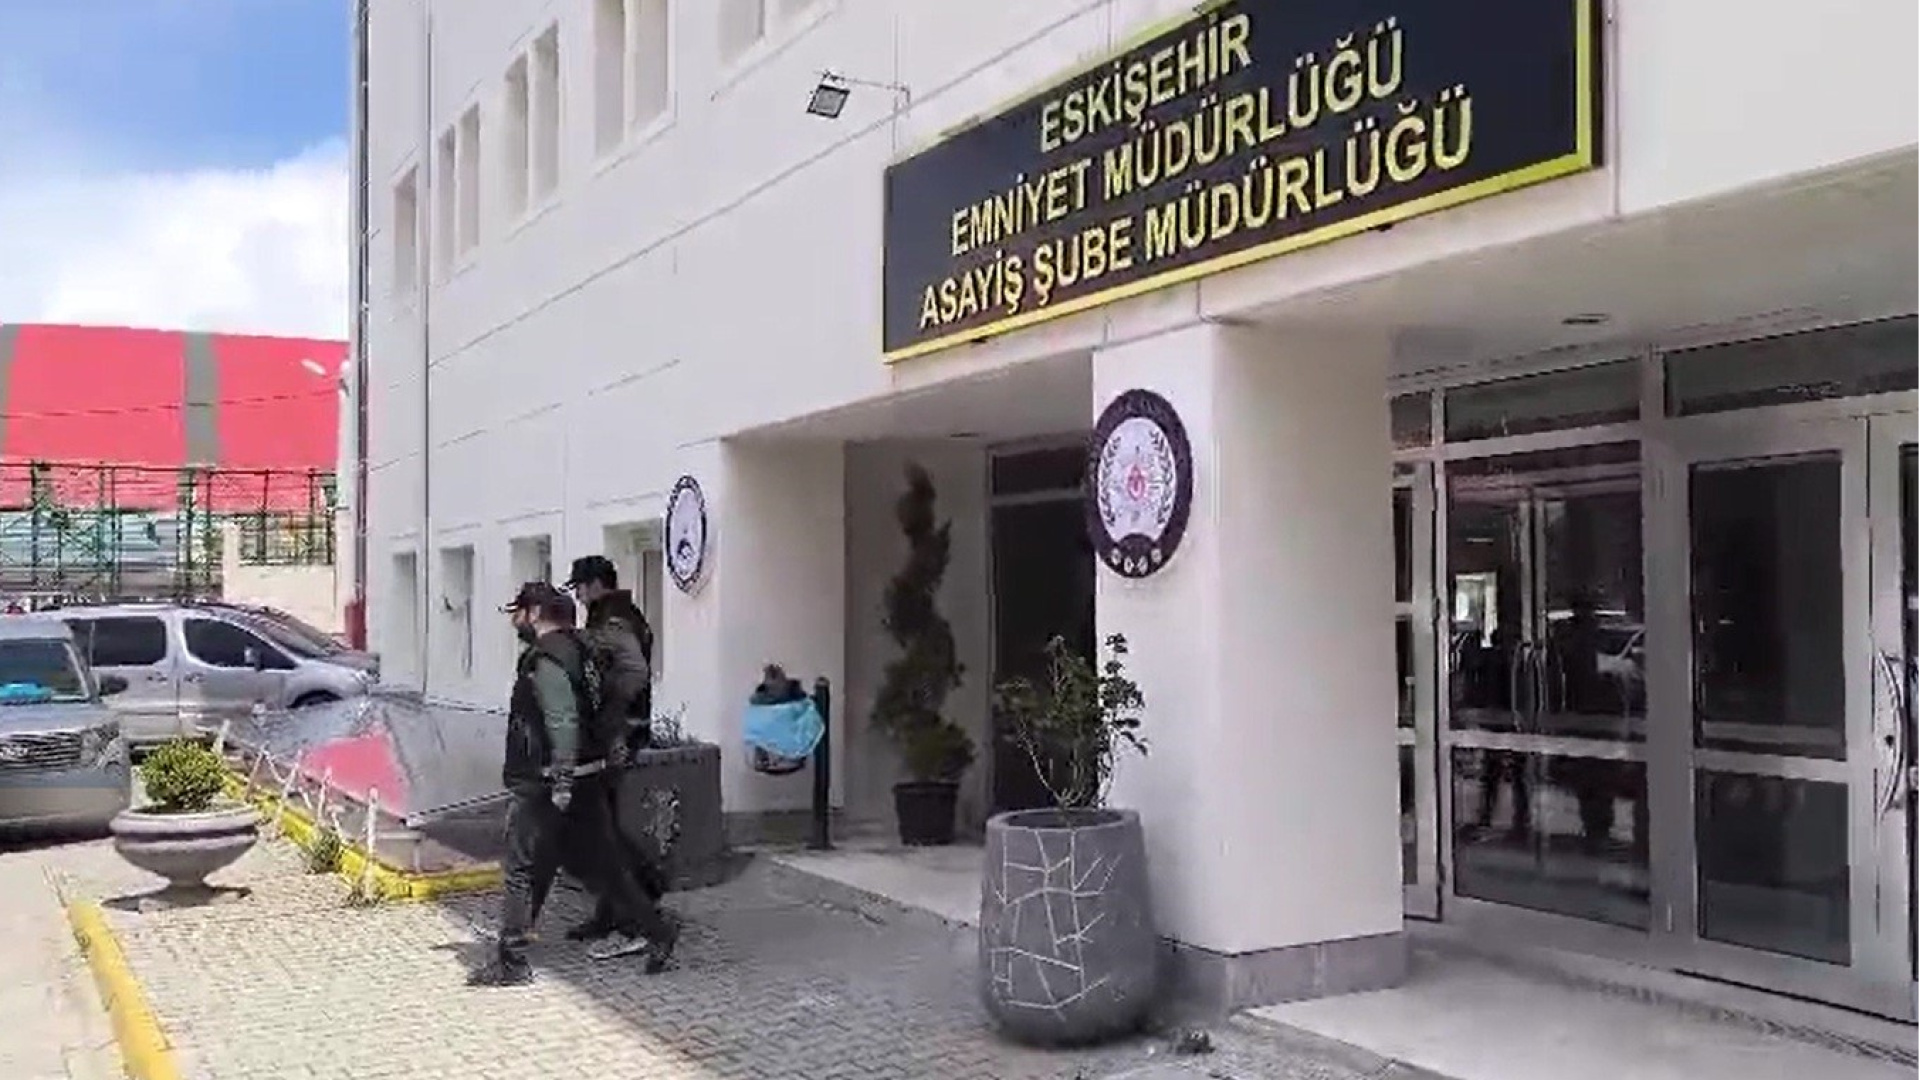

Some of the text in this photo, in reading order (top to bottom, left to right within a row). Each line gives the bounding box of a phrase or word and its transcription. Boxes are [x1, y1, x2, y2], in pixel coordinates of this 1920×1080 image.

[952, 18, 1404, 256] EMNİYET MÜDÜRLÜĞÜ
[1040, 13, 1253, 152] ESKİŞEHİR
[919, 83, 1473, 329] ASAYİŞ ŞUBE MÜDÜRLÜĞÜ
